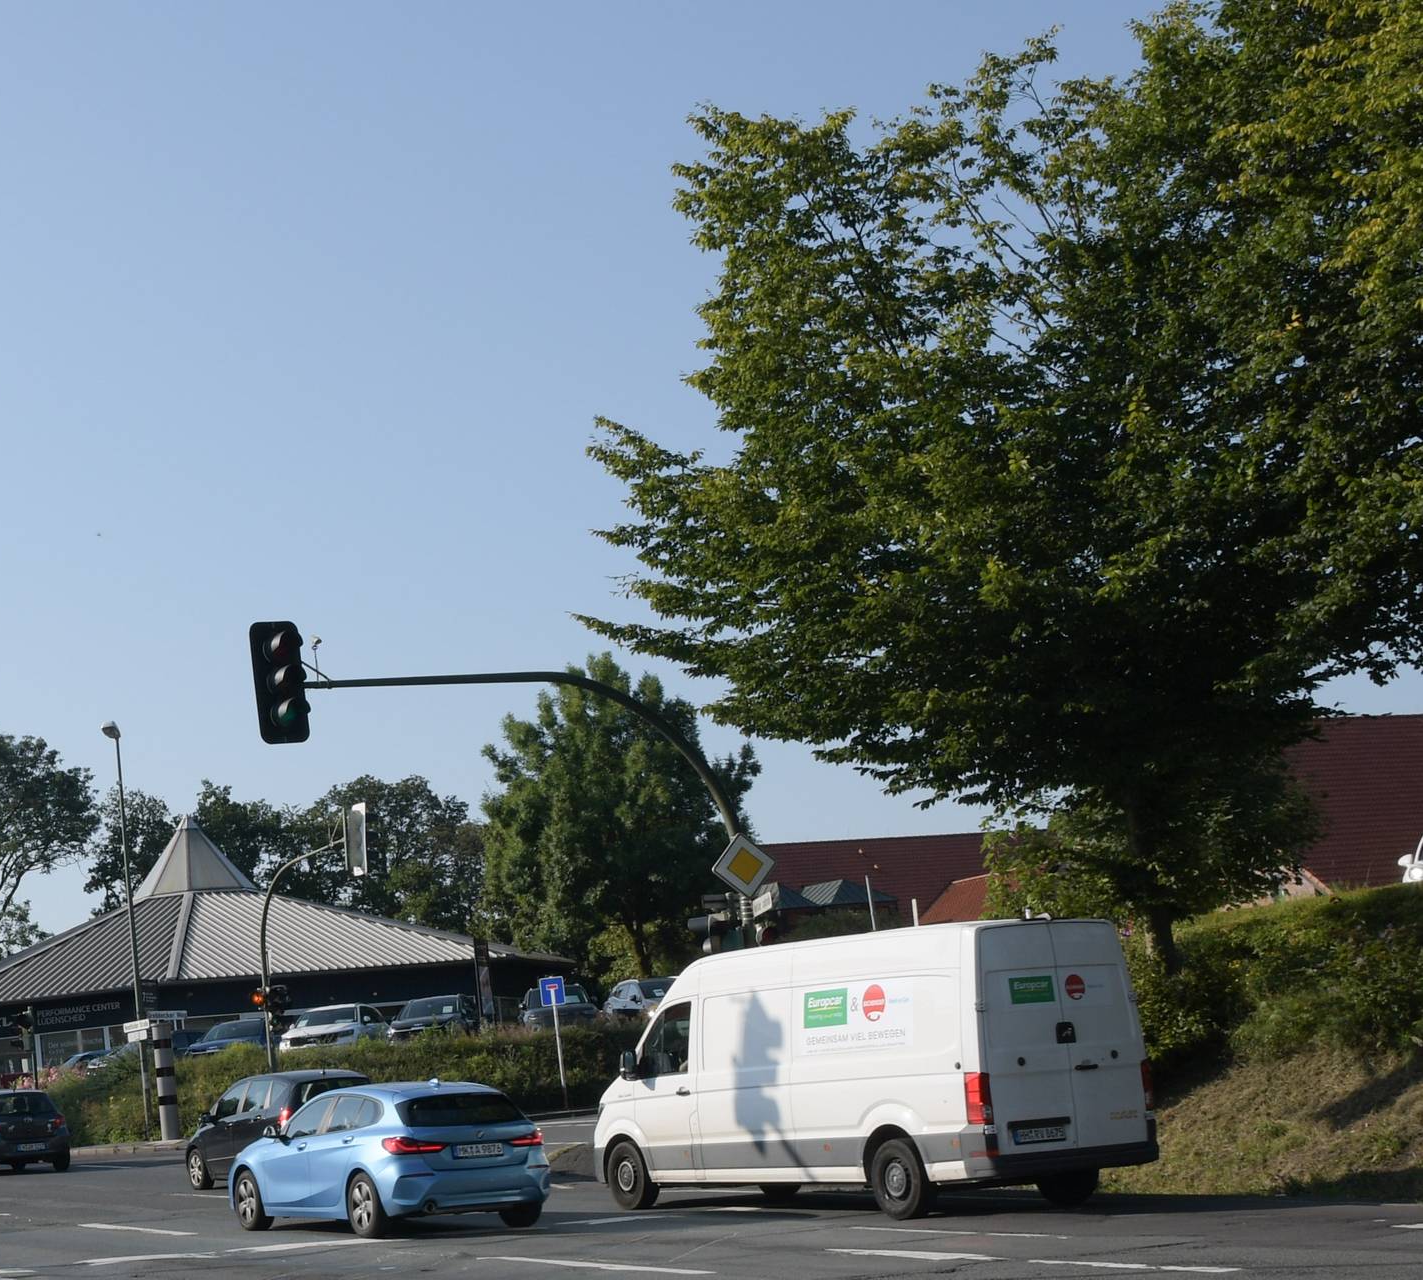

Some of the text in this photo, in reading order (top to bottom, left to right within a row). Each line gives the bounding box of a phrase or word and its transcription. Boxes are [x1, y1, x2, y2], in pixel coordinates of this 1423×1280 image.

[1014, 981, 1049, 991] Europcar
[808, 996, 843, 1008] Europcar
[37, 1002, 120, 1017] PERFORMANCE CENTER
[806, 1027, 906, 1046] GEMEINSAM VIEL BEWEGEN
